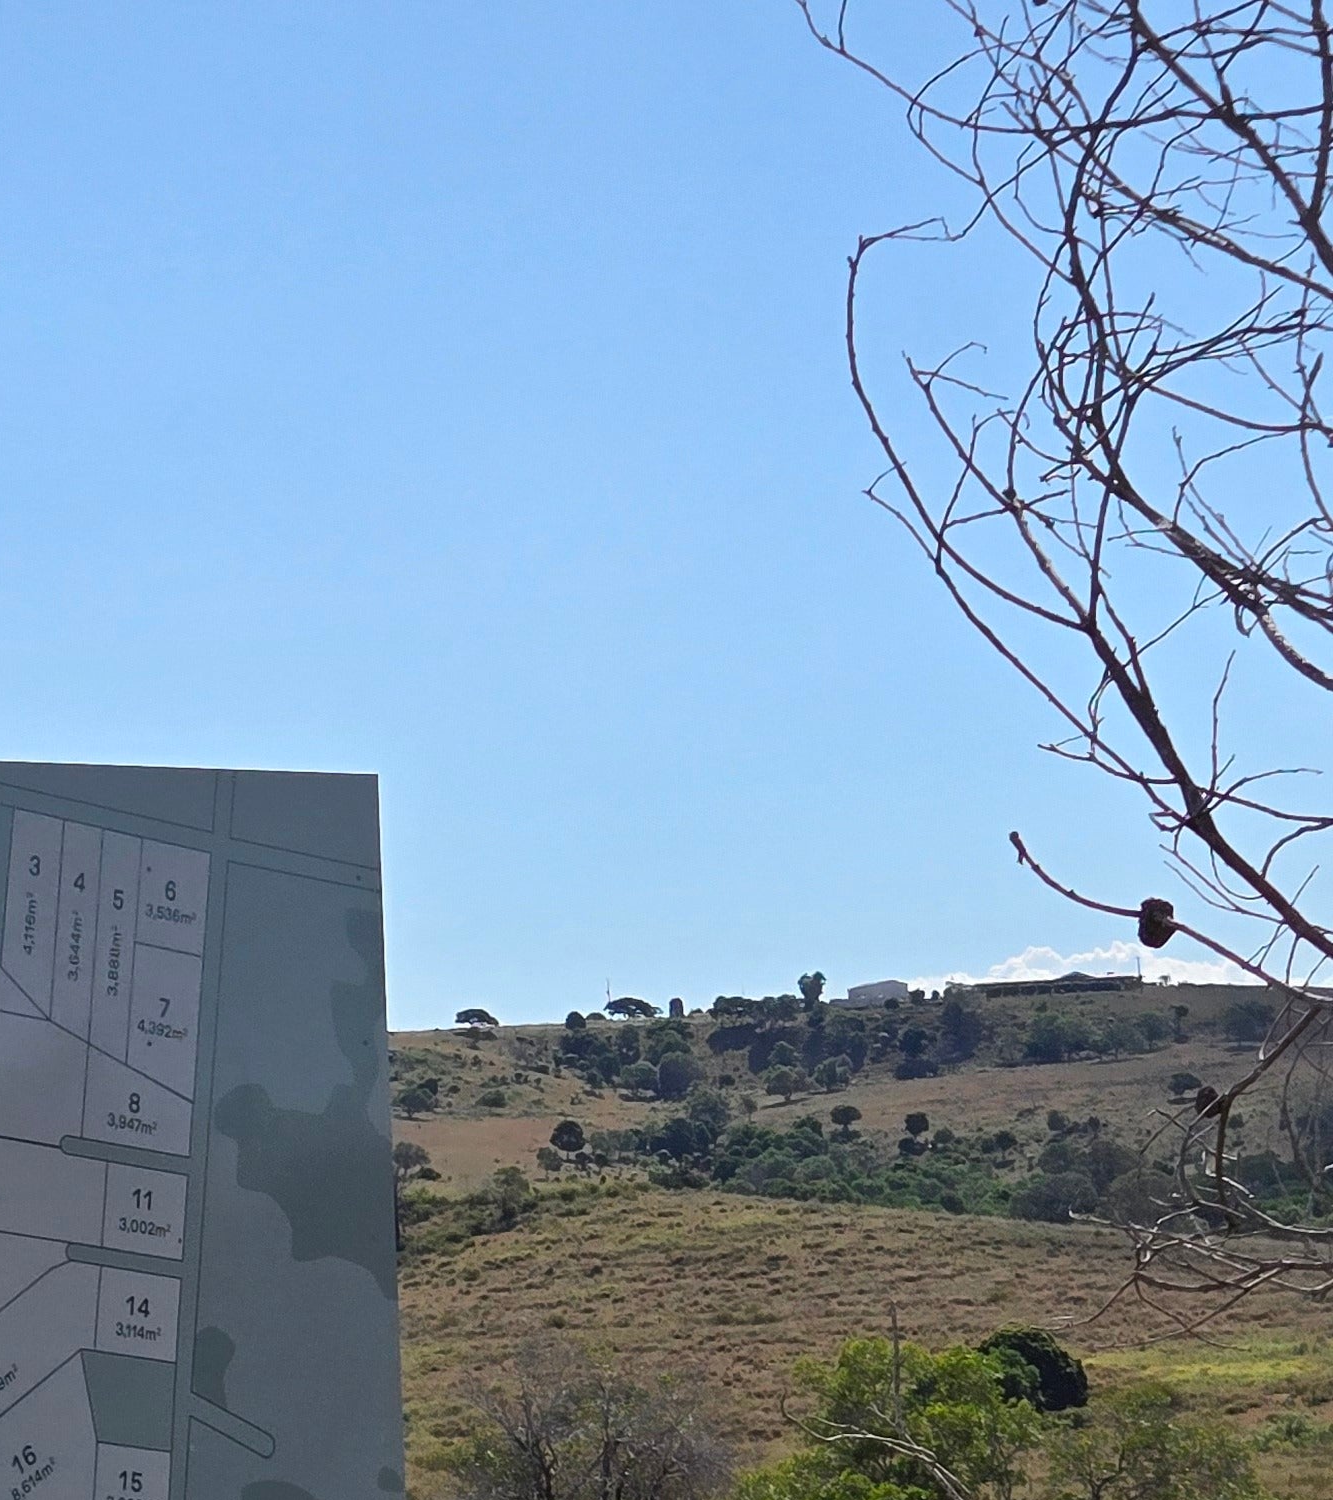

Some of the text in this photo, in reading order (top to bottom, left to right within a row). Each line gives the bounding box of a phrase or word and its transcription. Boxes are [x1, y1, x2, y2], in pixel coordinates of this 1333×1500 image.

[29, 855, 40, 876] 3
[74, 873, 85, 892] 4
[165, 881, 176, 901] 6
[113, 889, 123, 910] 5
[159, 998, 170, 1017] 7
[129, 1093, 140, 1113] 8
[133, 1189, 152, 1210] 11
[126, 1296, 150, 1317] 14
[12, 1445, 37, 1473] 16
[119, 1471, 142, 1492] 15
